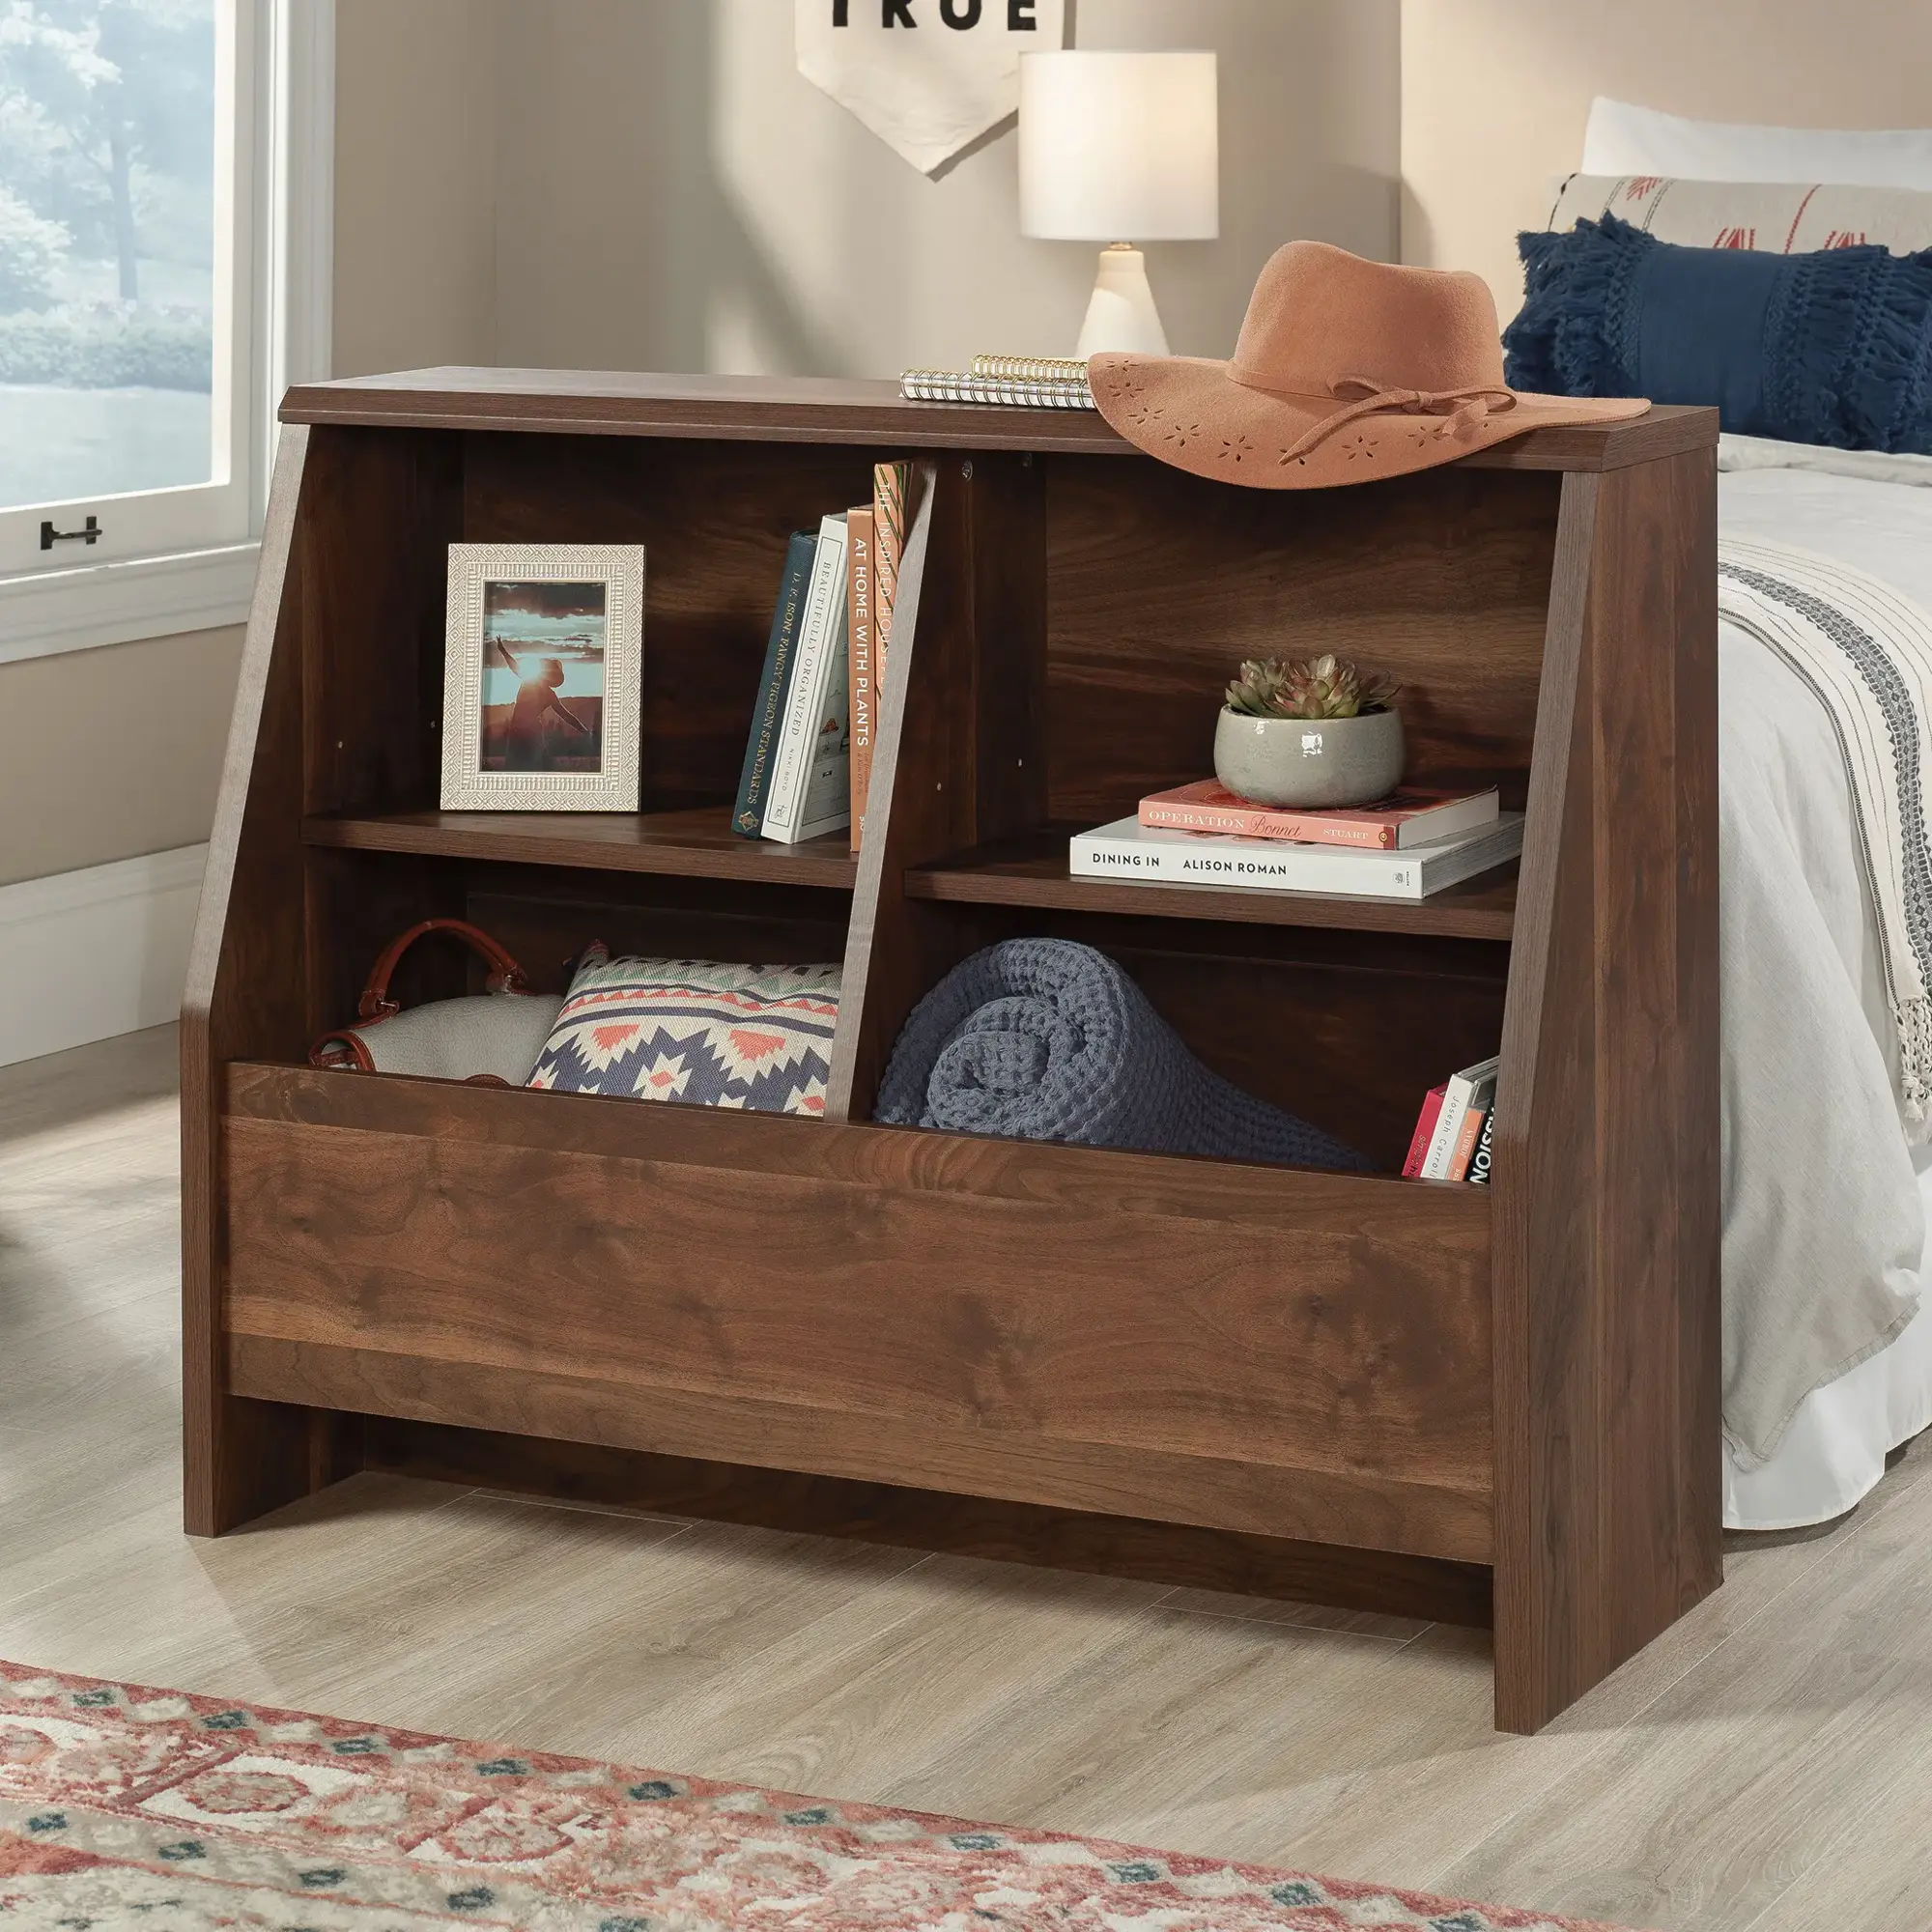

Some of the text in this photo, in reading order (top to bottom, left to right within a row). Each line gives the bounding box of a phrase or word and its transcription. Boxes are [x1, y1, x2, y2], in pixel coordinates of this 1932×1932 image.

[878, 484, 891, 510] THE
[855, 538, 867, 560] AT
[879, 522, 891, 597] INSPIRED
[856, 566, 867, 618] HOME
[775, 638, 789, 678] FANCY
[792, 562, 831, 736] BEAUTIFULLY ORGANIZED
[856, 625, 867, 670] WITH
[763, 681, 781, 731] PIGEON
[857, 677, 868, 746] PLANTS
[748, 730, 771, 804] STANDARDS
[1149, 810, 1369, 840] OPERATION Bonnet STUART
[1093, 853, 1287, 875] DINING IN ALISON ROMAN
[1430, 1096, 1460, 1179] Joseph Carroll
